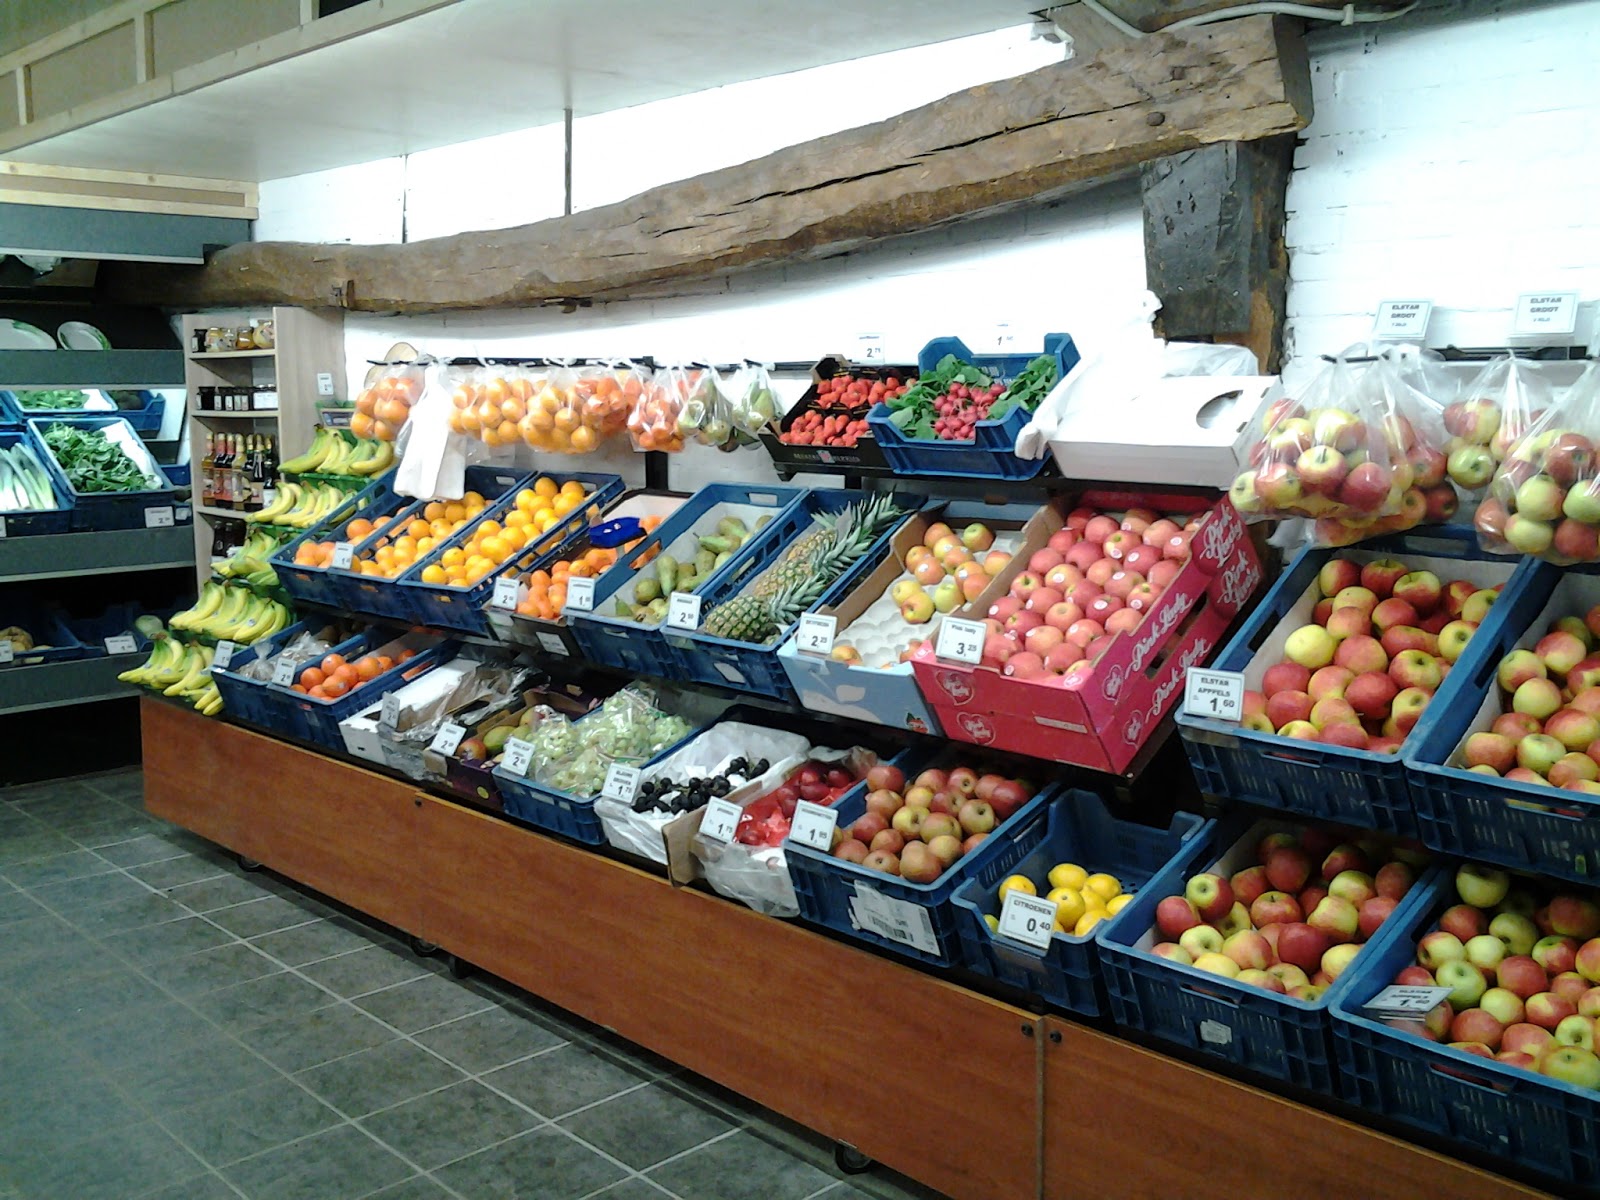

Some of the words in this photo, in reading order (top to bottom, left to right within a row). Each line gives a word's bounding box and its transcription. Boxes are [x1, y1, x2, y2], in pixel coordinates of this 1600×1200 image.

[1200, 503, 1232, 560] Pink
[1217, 549, 1249, 604] Pink
[1125, 622, 1159, 680] Pink
[1160, 592, 1193, 634] Lady
[1145, 667, 1178, 724] Pink
[1201, 677, 1229, 687] ELSTAR
[1014, 900, 1051, 916] CITROENEN
